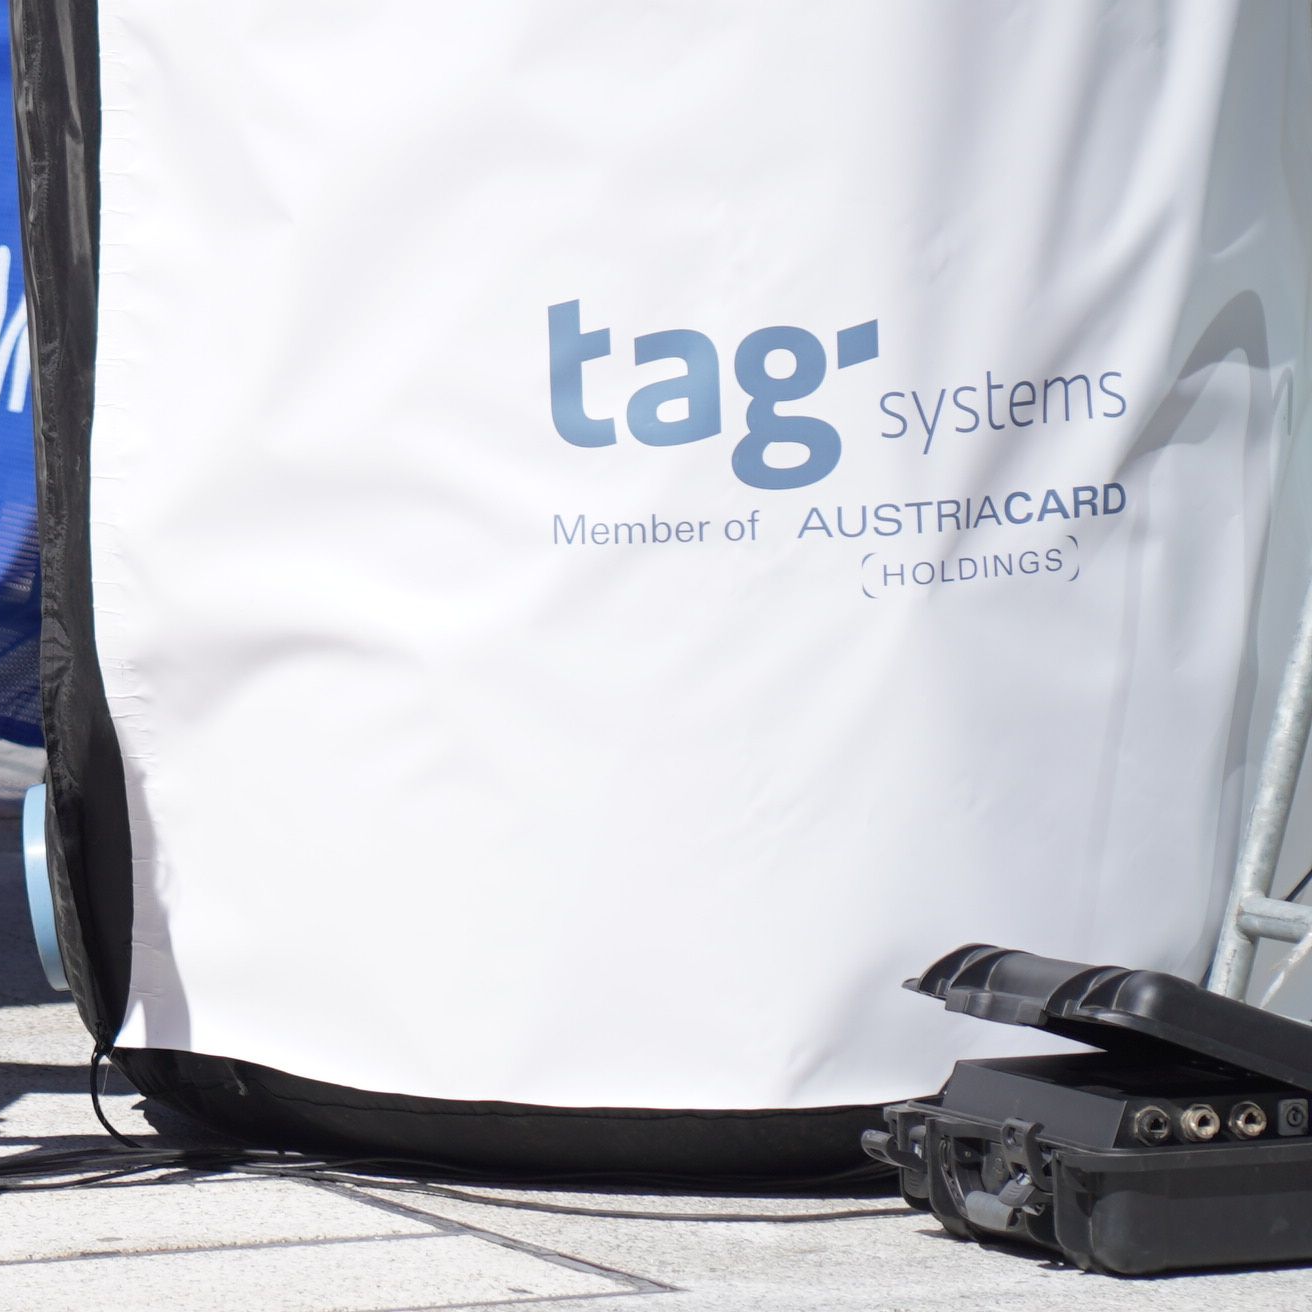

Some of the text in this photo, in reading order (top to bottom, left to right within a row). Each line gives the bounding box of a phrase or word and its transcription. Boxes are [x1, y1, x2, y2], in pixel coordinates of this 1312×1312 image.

[879, 371, 1127, 454] systems
[553, 482, 1127, 545] Member of AUSTRIACARD
